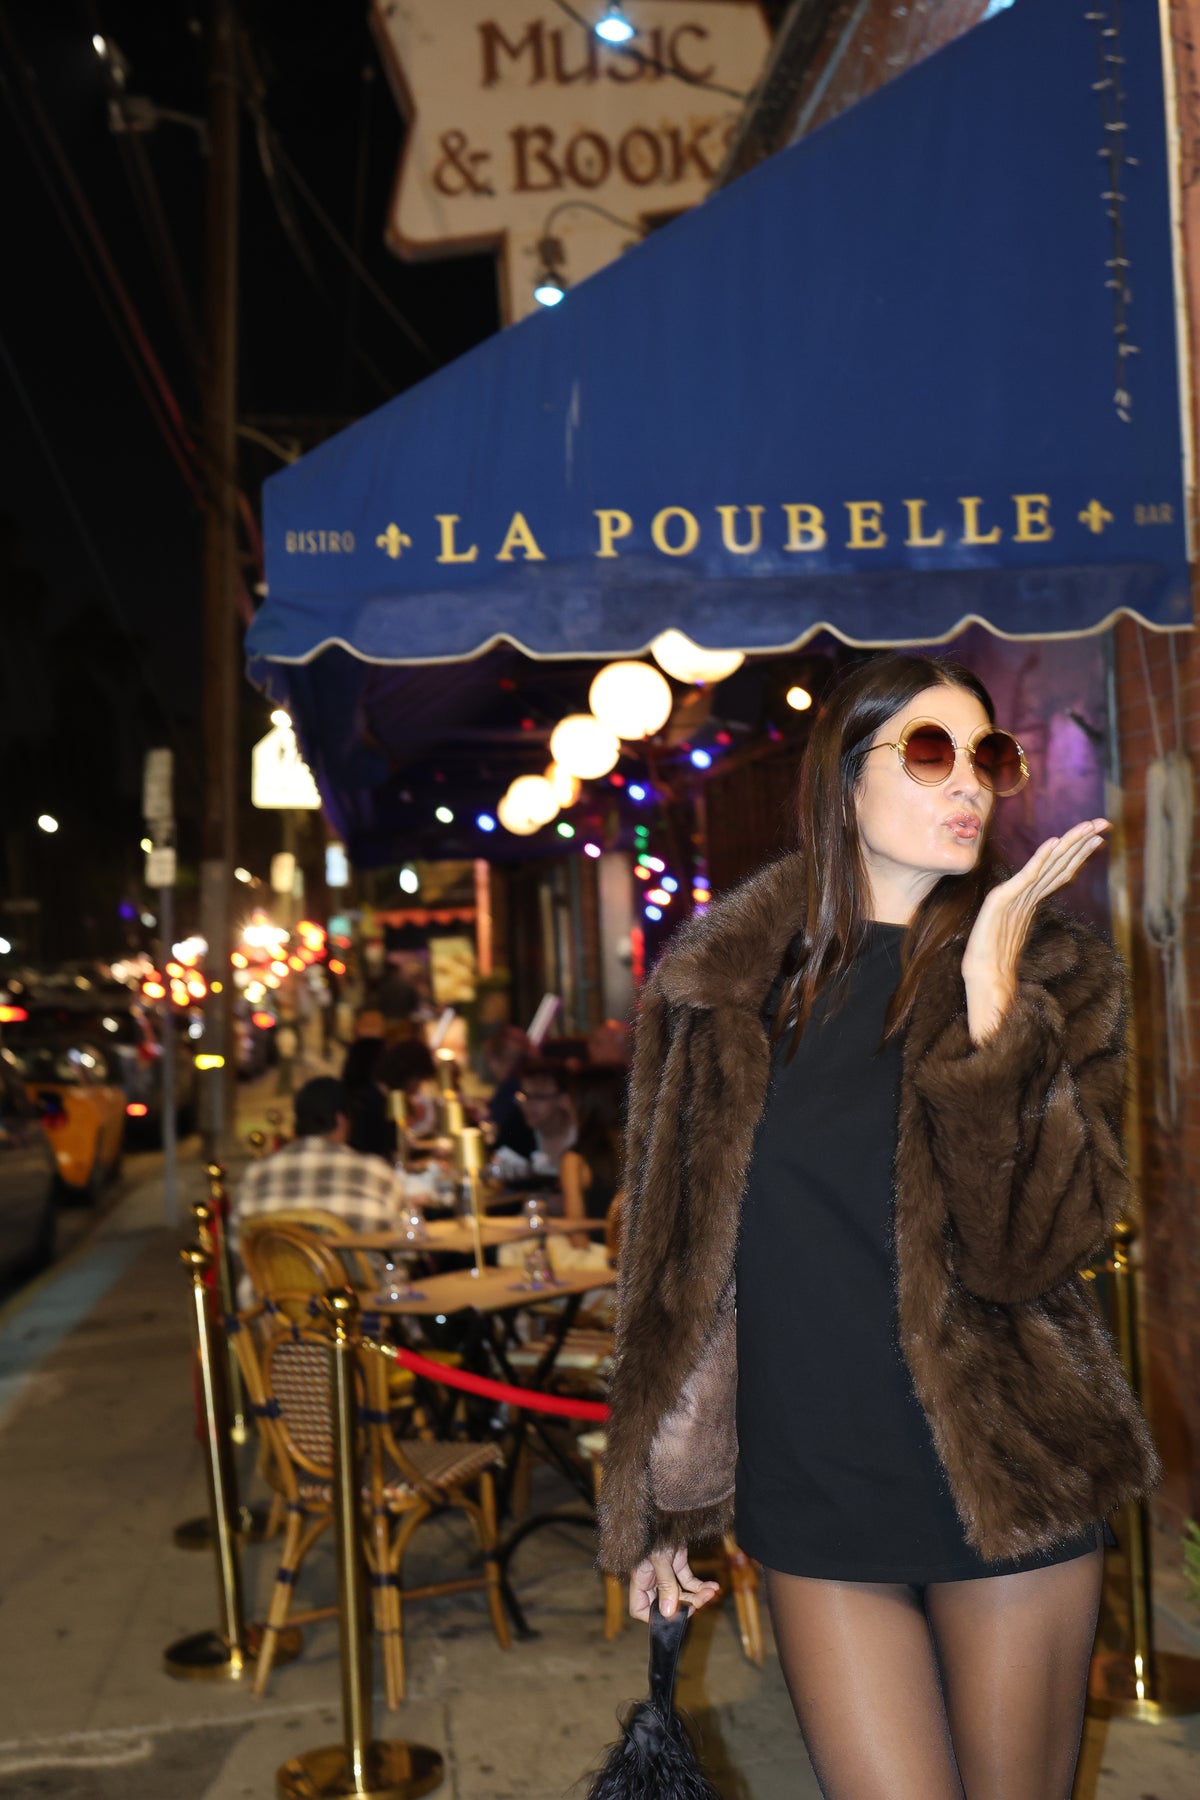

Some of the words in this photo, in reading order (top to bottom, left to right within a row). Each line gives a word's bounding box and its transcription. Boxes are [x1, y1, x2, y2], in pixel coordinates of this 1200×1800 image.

[477, 18, 716, 88] MUSIC
[432, 129, 495, 197] &
[285, 529, 355, 555] BISTRO
[434, 512, 546, 564] LA
[593, 494, 1055, 557] POUBELLE
[1134, 502, 1173, 527] BAR
